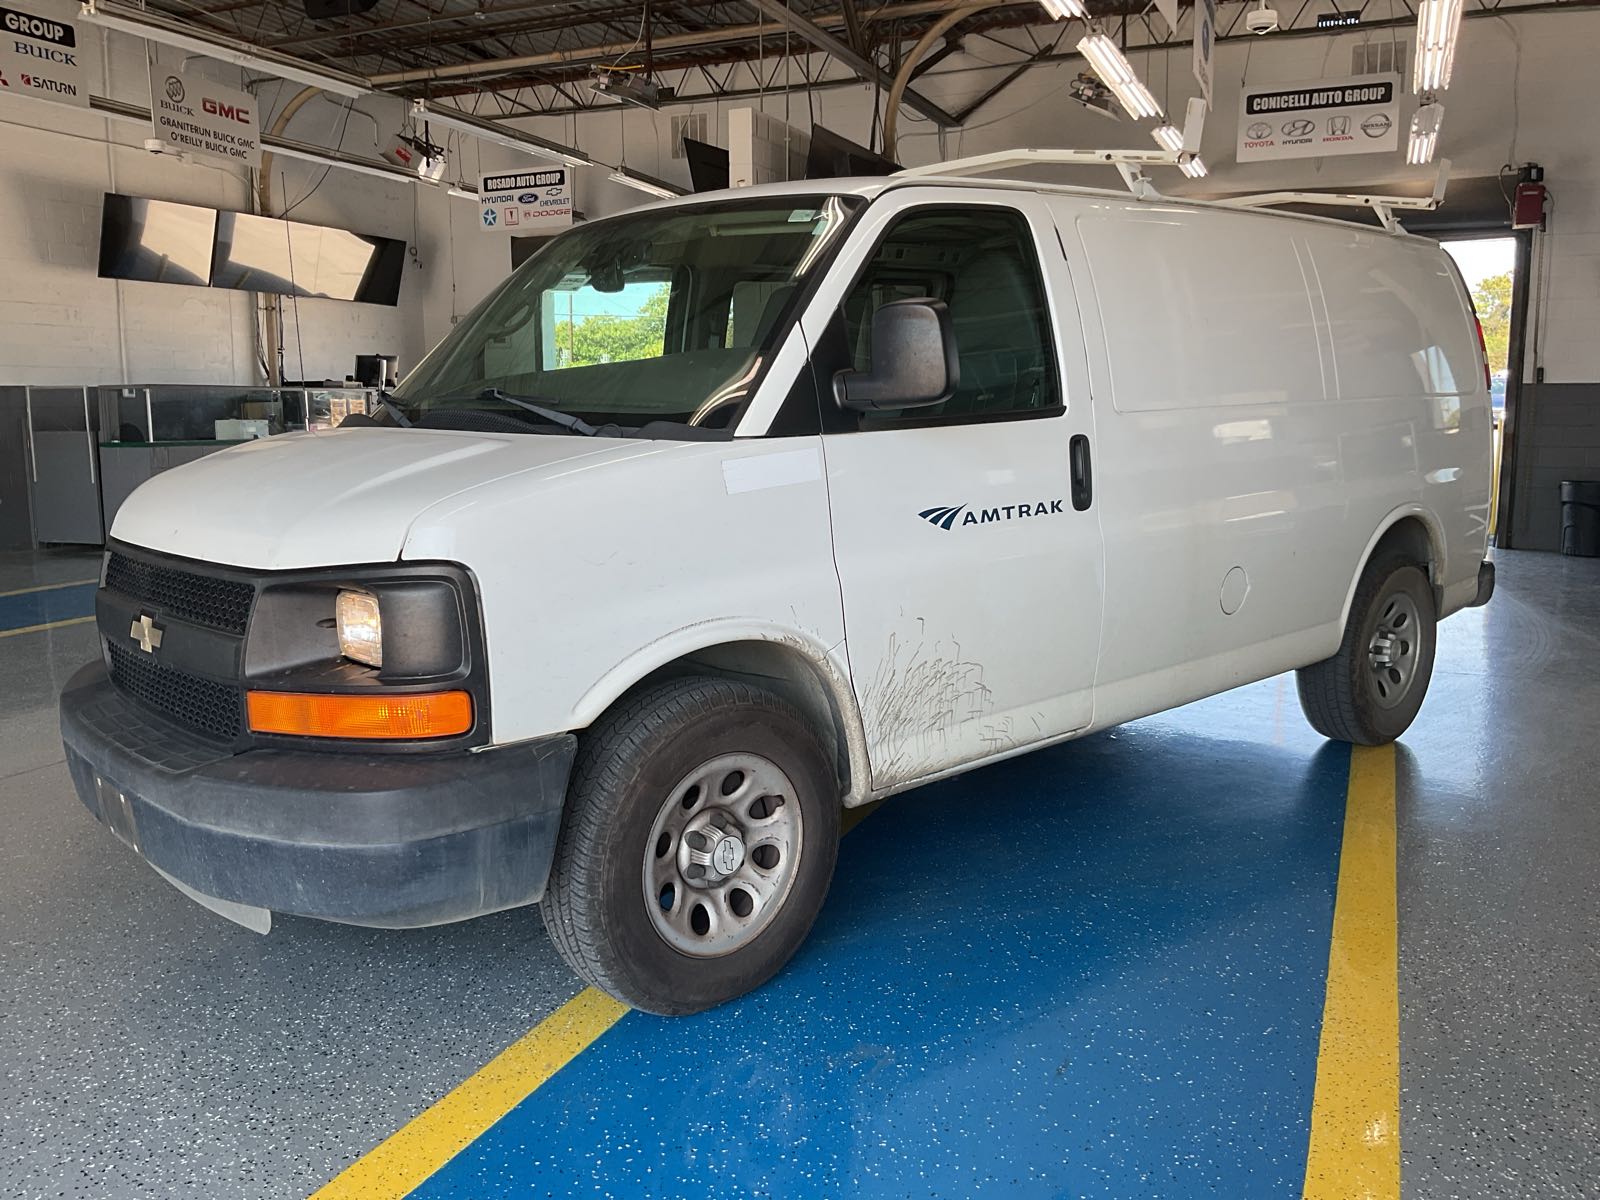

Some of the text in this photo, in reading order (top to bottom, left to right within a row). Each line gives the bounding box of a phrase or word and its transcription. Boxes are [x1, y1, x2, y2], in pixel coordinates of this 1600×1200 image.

[5, 13, 64, 40] GROUP
[14, 41, 77, 67] BUICK
[33, 77, 77, 96] SATURN
[160, 99, 194, 117] BUICK
[1253, 87, 1385, 110] CONICELLI AUTO GROUP
[202, 97, 250, 124] GMC
[160, 116, 255, 149] GRANITERUN BUICK GMC
[170, 131, 247, 159] O'REILLY BUICK GMC
[1244, 140, 1274, 149] TOYOTA
[487, 172, 561, 190] ROSADO AUTO GROUP
[481, 195, 514, 204] HYUNDAI
[540, 198, 570, 207] CHEVROLET
[532, 208, 571, 217] DODGE
[962, 499, 1063, 526] AMTRAK
